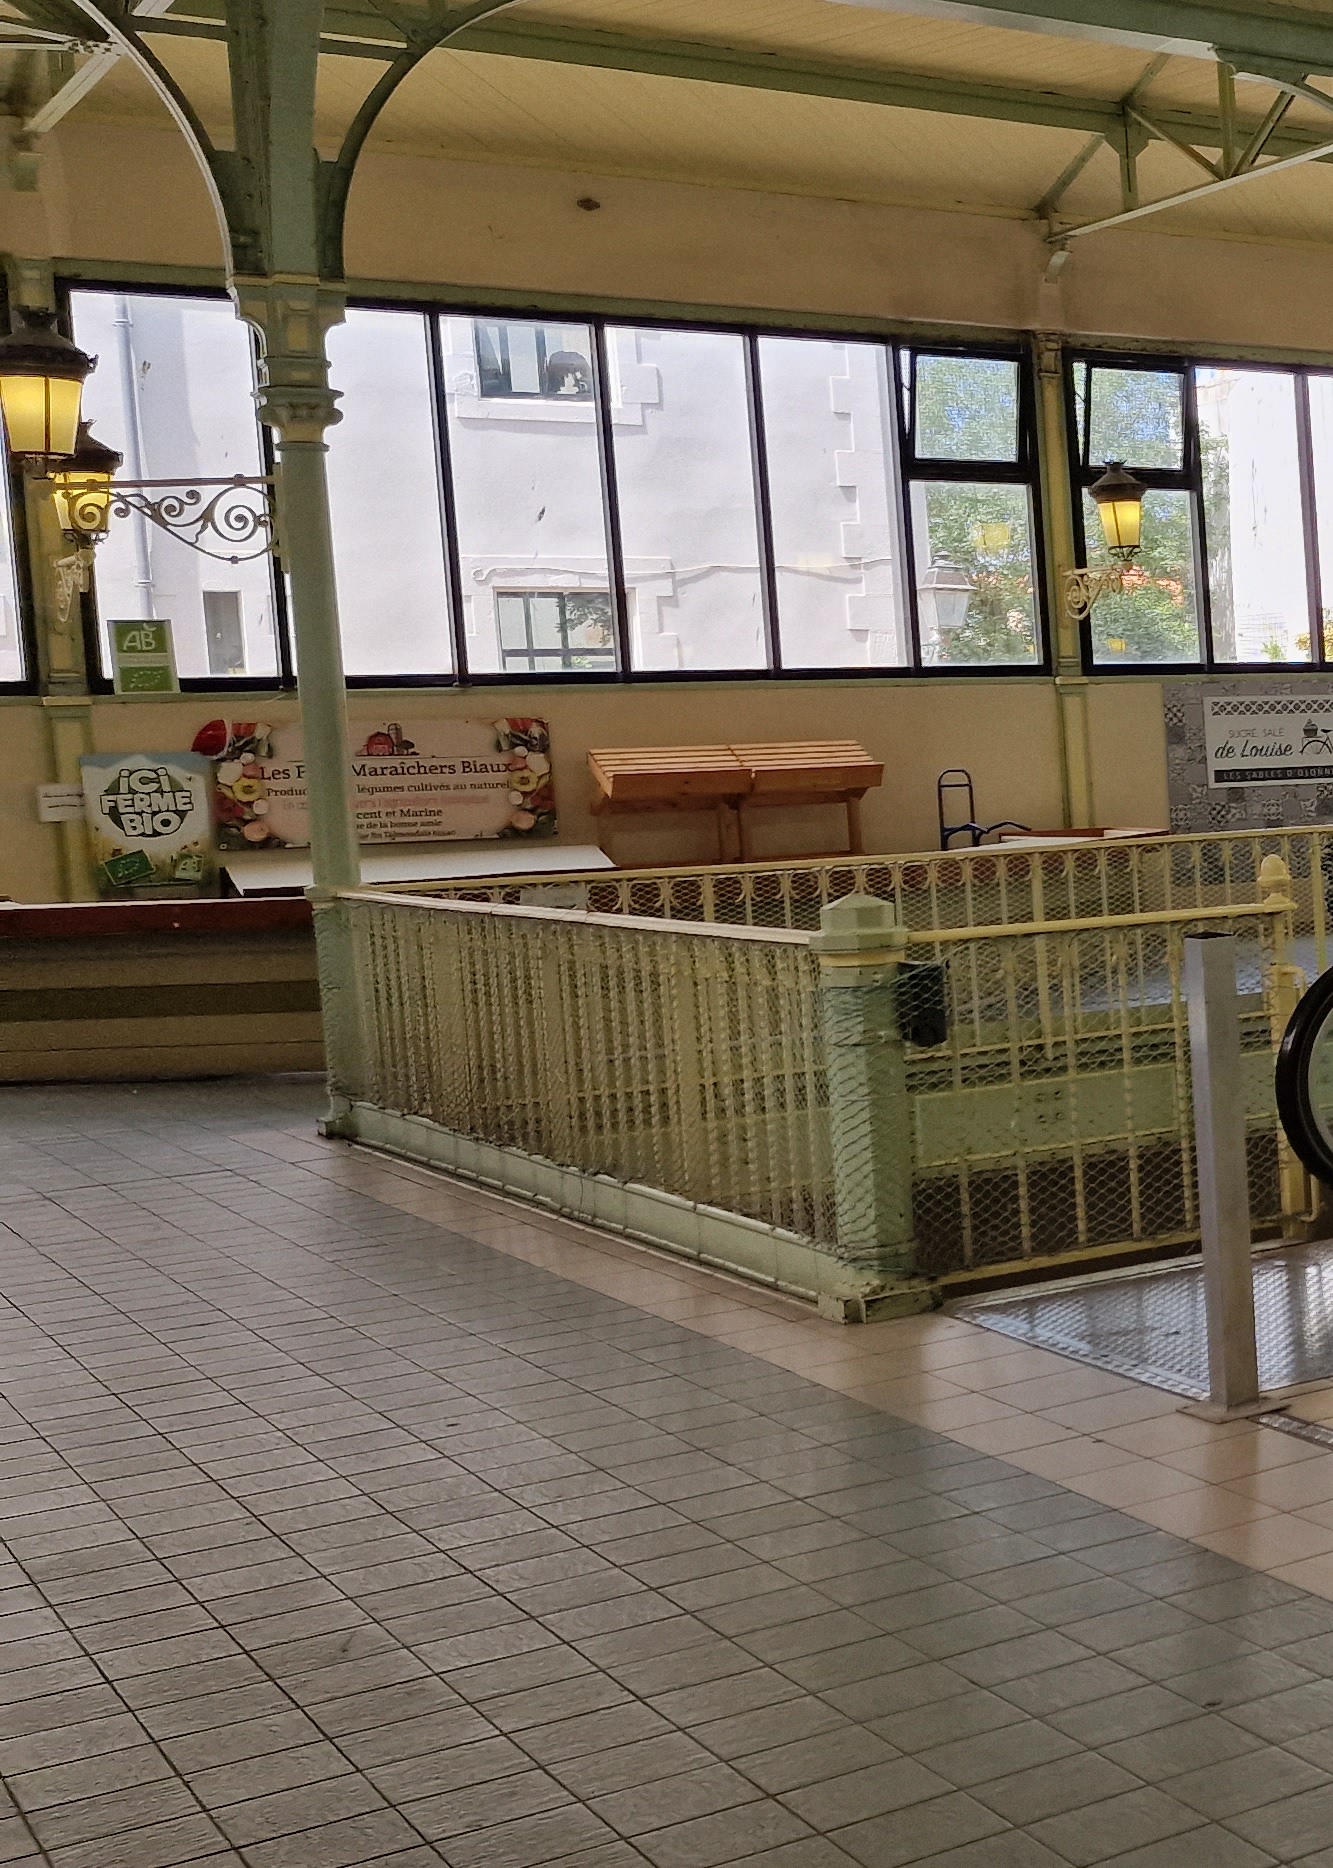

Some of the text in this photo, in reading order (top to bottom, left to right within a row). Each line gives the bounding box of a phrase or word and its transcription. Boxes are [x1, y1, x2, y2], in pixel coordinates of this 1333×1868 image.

[1214, 739, 1294, 759] de Louise
[260, 766, 291, 781] Les
[351, 761, 457, 777] Maraîchers
[460, 759, 513, 775] Biaux
[1223, 772, 1241, 780] LES
[1245, 769, 1283, 779] SABLES
[266, 786, 308, 797] Produc
[356, 783, 405, 796] légumes
[407, 782, 451, 793] cultivés
[469, 780, 511, 790] naturel
[100, 790, 194, 815] FERME
[400, 808, 443, 818] Marine
[121, 812, 182, 837] BIO
